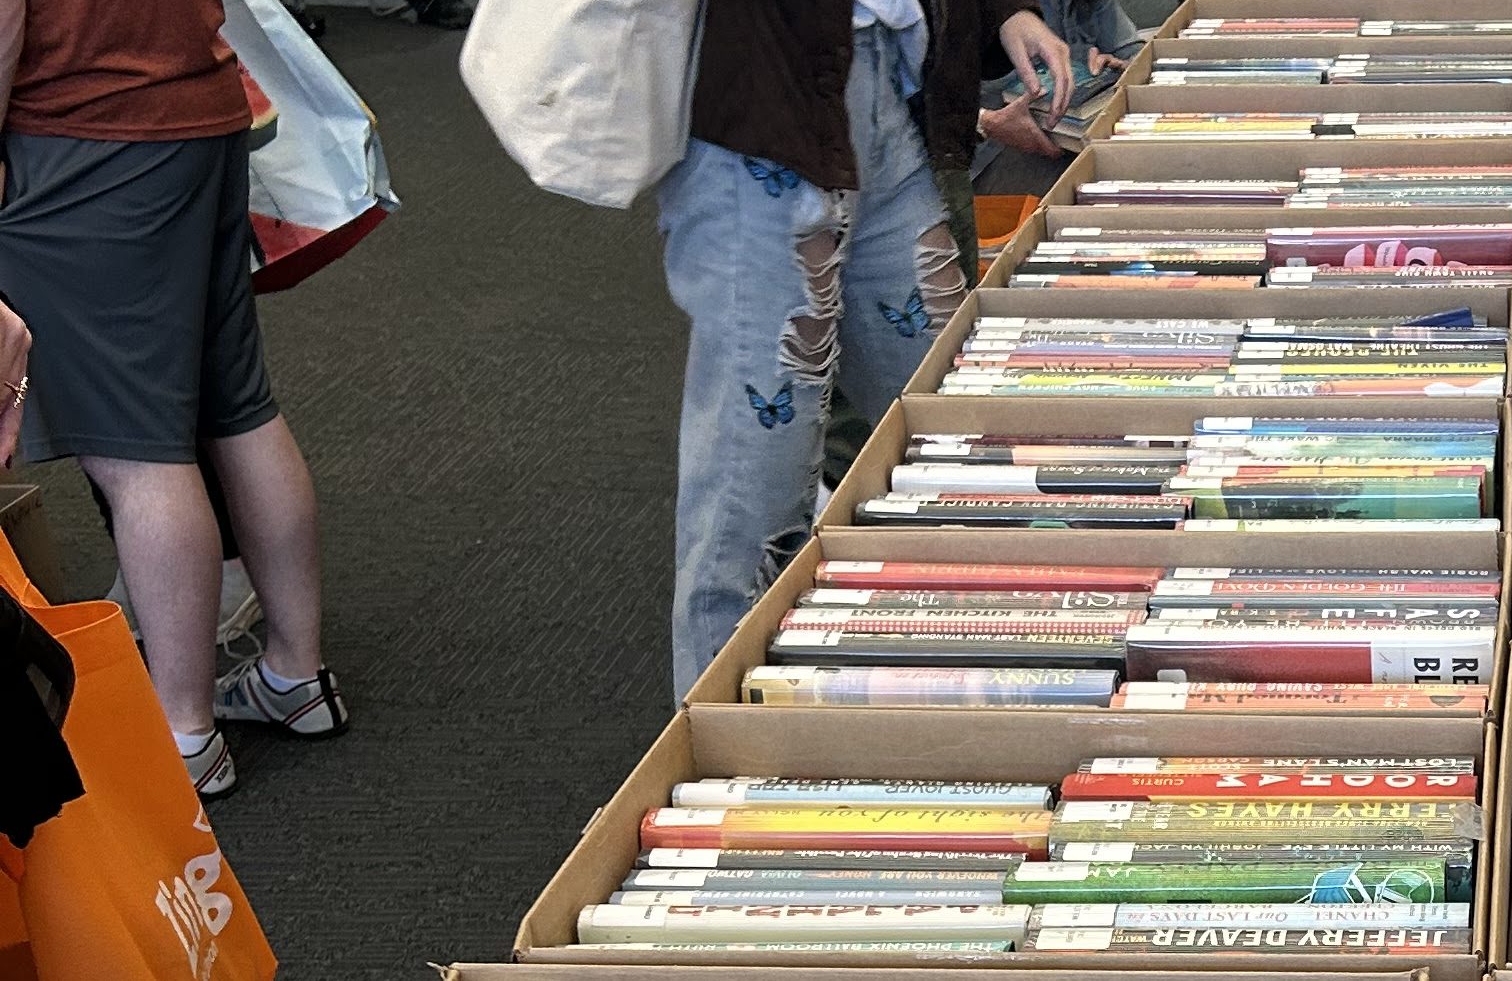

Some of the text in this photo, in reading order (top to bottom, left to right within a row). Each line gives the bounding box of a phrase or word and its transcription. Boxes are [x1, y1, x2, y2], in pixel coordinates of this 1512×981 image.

[1027, 634, 1112, 645] SEVENTEEN
[1451, 657, 1479, 684] RE
[989, 671, 1075, 685] SUNNY
[1263, 758, 1319, 767] LANE
[1131, 778, 1184, 787] CURTIS
[1186, 802, 1313, 818] HAYES
[1150, 911, 1204, 922] DAYS
[1211, 911, 1251, 922] LAST
[1255, 912, 1288, 923] Our
[1150, 928, 1448, 947] JEFFERY DEAVER
